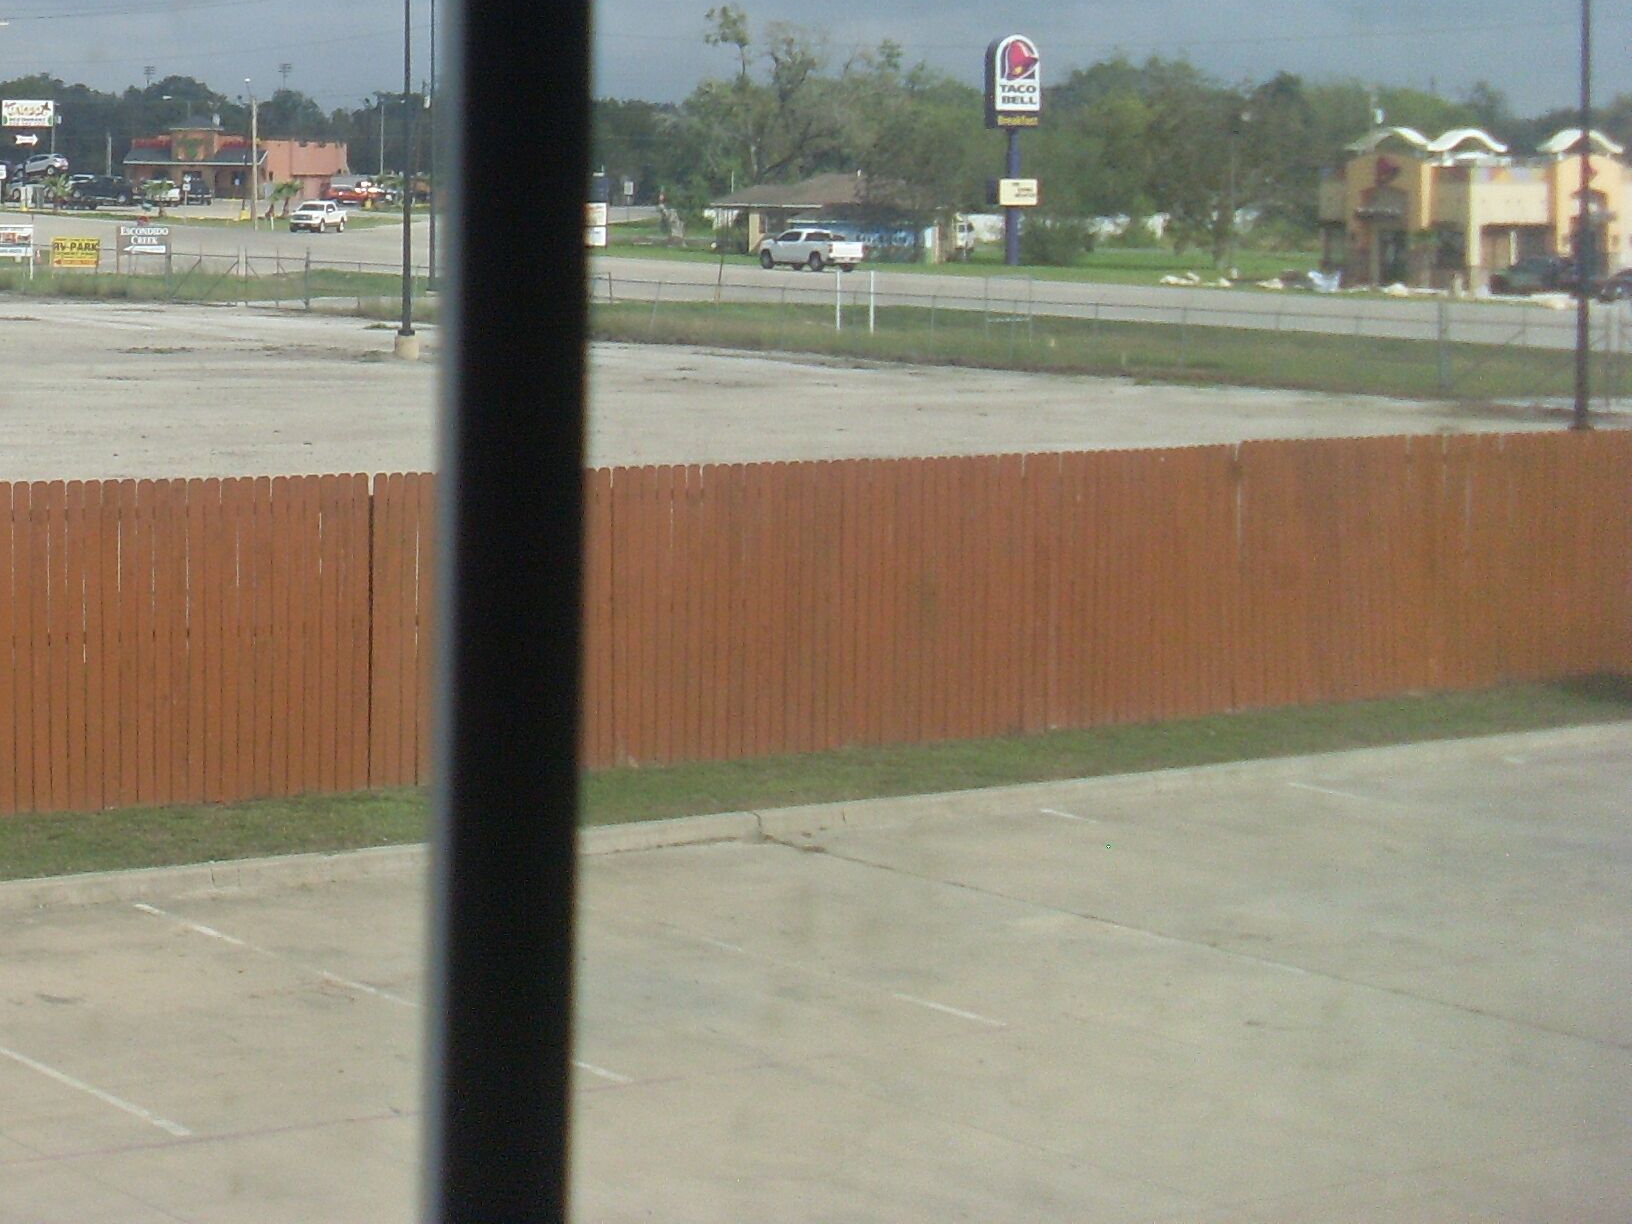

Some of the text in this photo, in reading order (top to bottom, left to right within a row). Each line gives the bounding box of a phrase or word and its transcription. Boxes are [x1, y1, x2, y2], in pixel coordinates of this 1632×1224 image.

[1000, 84, 1037, 94] TACO
[1001, 95, 1037, 105] BELL
[120, 226, 169, 236] ESCONDIDO
[70, 242, 98, 251] PARK
